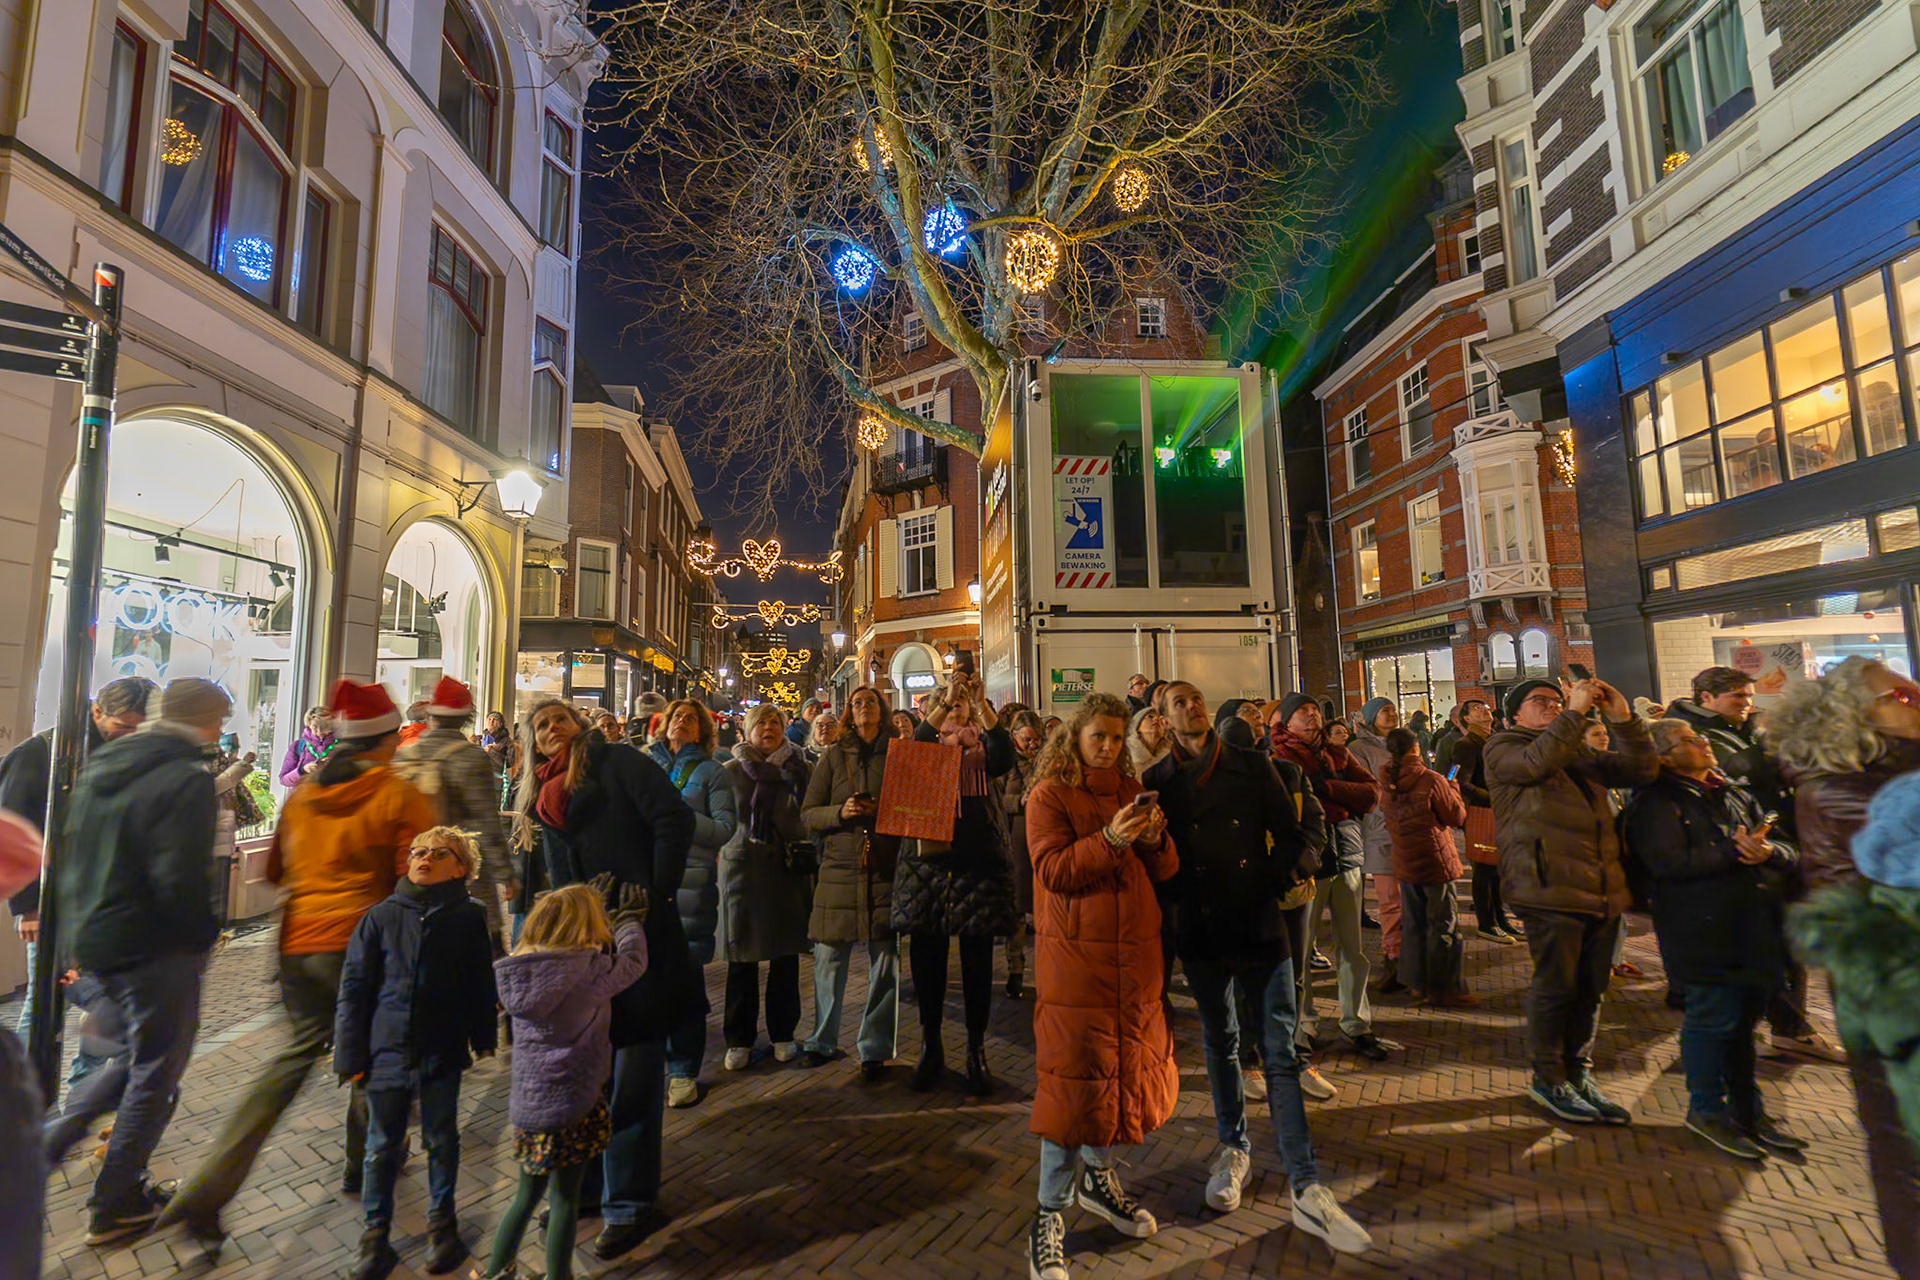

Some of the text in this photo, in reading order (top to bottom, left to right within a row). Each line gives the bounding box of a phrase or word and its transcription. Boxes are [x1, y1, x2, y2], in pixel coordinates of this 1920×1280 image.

[22, 250, 66, 290] Speelklok
[68, 316, 75, 324] 1
[61, 362, 69, 370] 2
[1071, 486, 1090, 495] 24/7
[1065, 552, 1101, 560] CAMERA
[1239, 635, 1258, 646] 1054
[1052, 682, 1094, 692] PIETERSE
